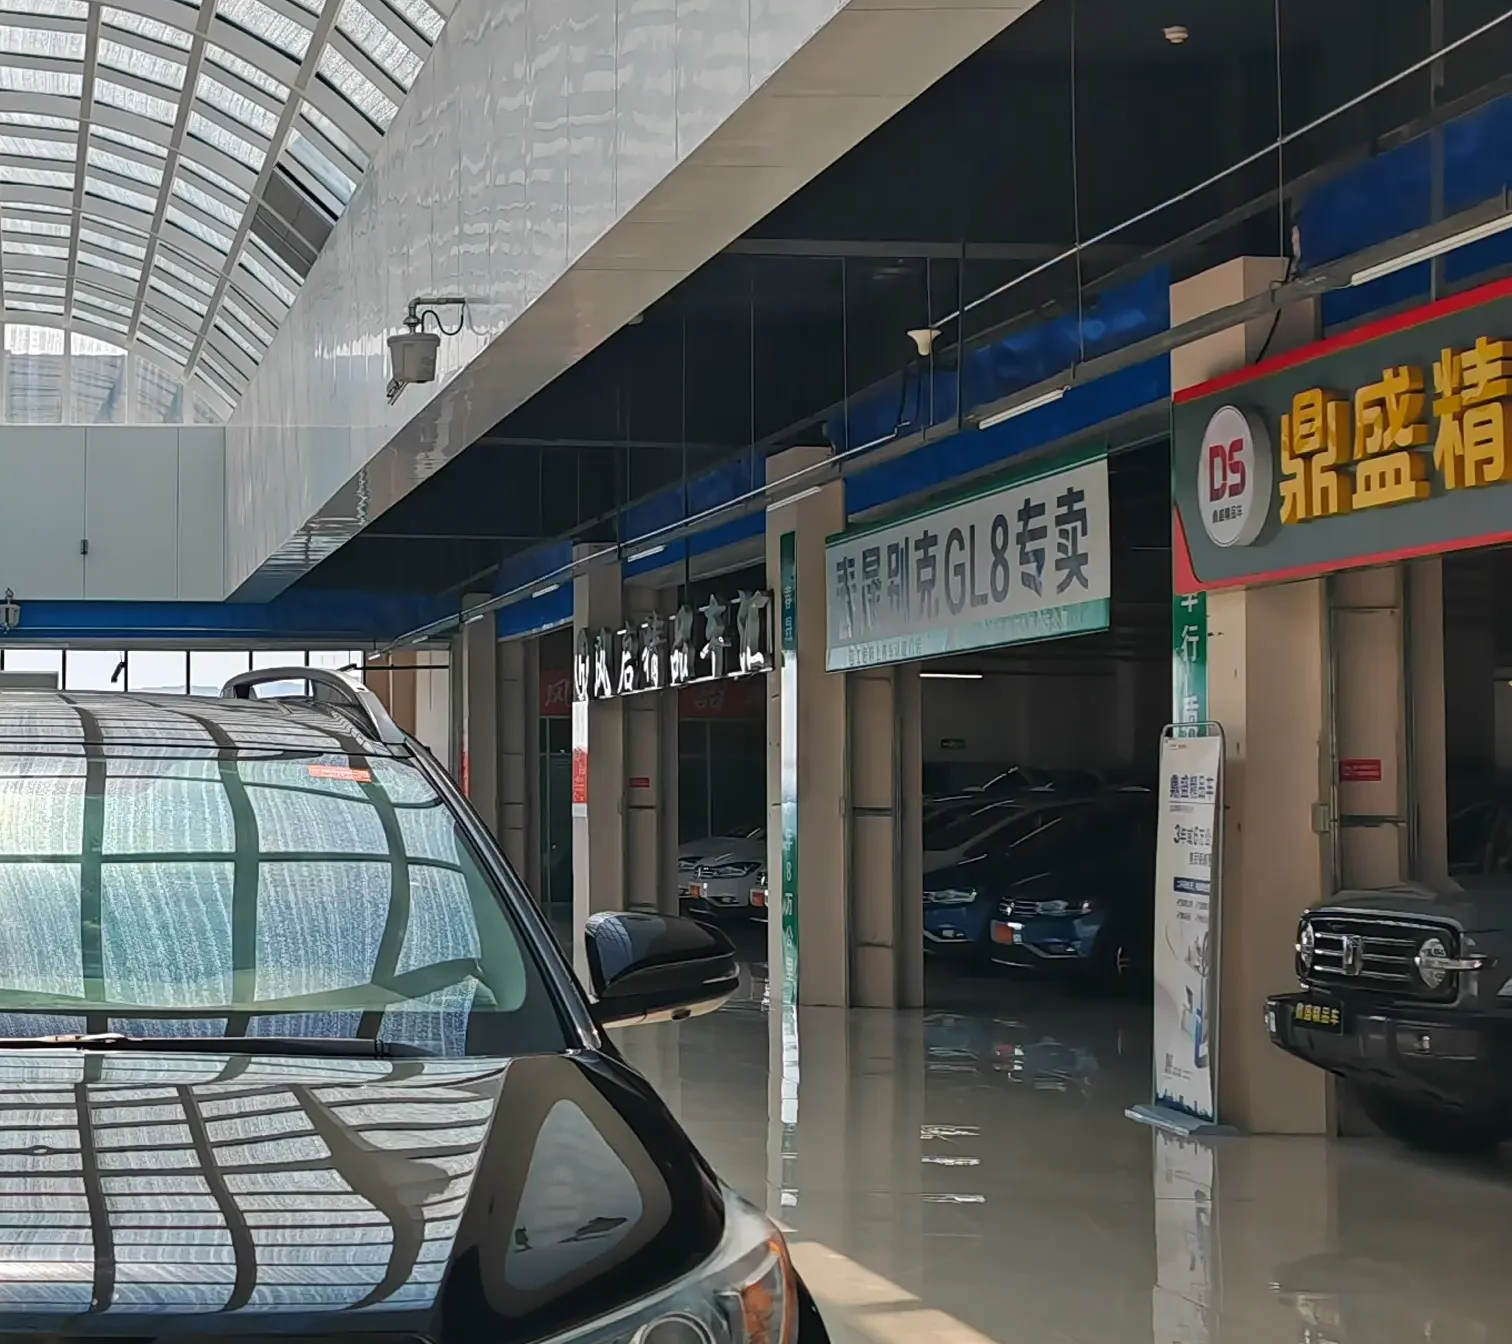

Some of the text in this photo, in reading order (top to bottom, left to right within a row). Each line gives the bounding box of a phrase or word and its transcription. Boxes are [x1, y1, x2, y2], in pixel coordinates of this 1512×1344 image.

[1208, 438, 1246, 502] DS
[1280, 336, 1512, 524] 鼎盛精
